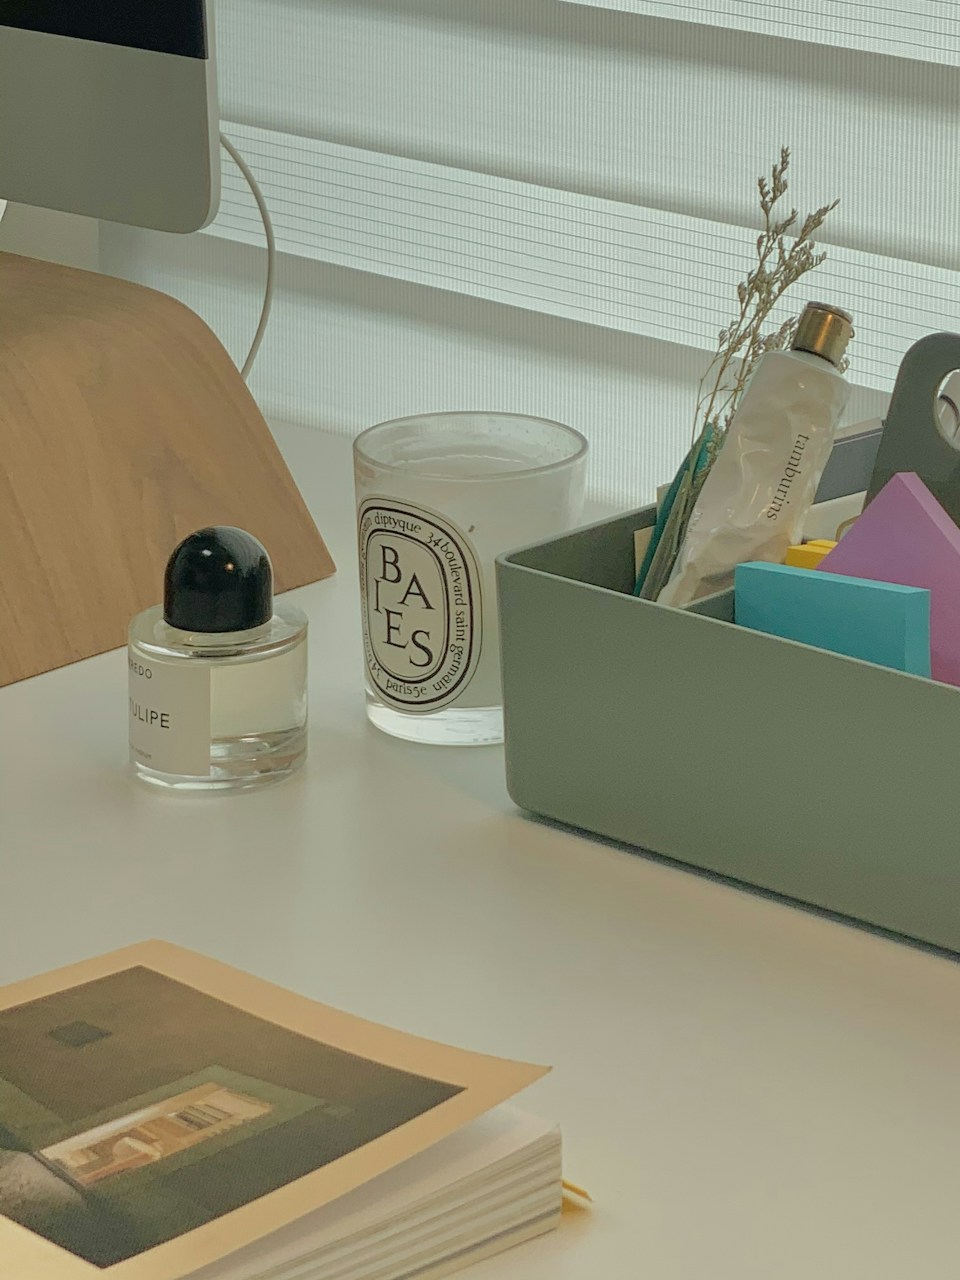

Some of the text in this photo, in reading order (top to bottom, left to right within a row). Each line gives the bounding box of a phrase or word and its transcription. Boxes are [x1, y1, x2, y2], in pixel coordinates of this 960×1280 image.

[767, 434, 810, 521] tamburins
[374, 512, 422, 534] diptyque
[455, 610, 468, 641] saint
[432, 643, 464, 691] germain
